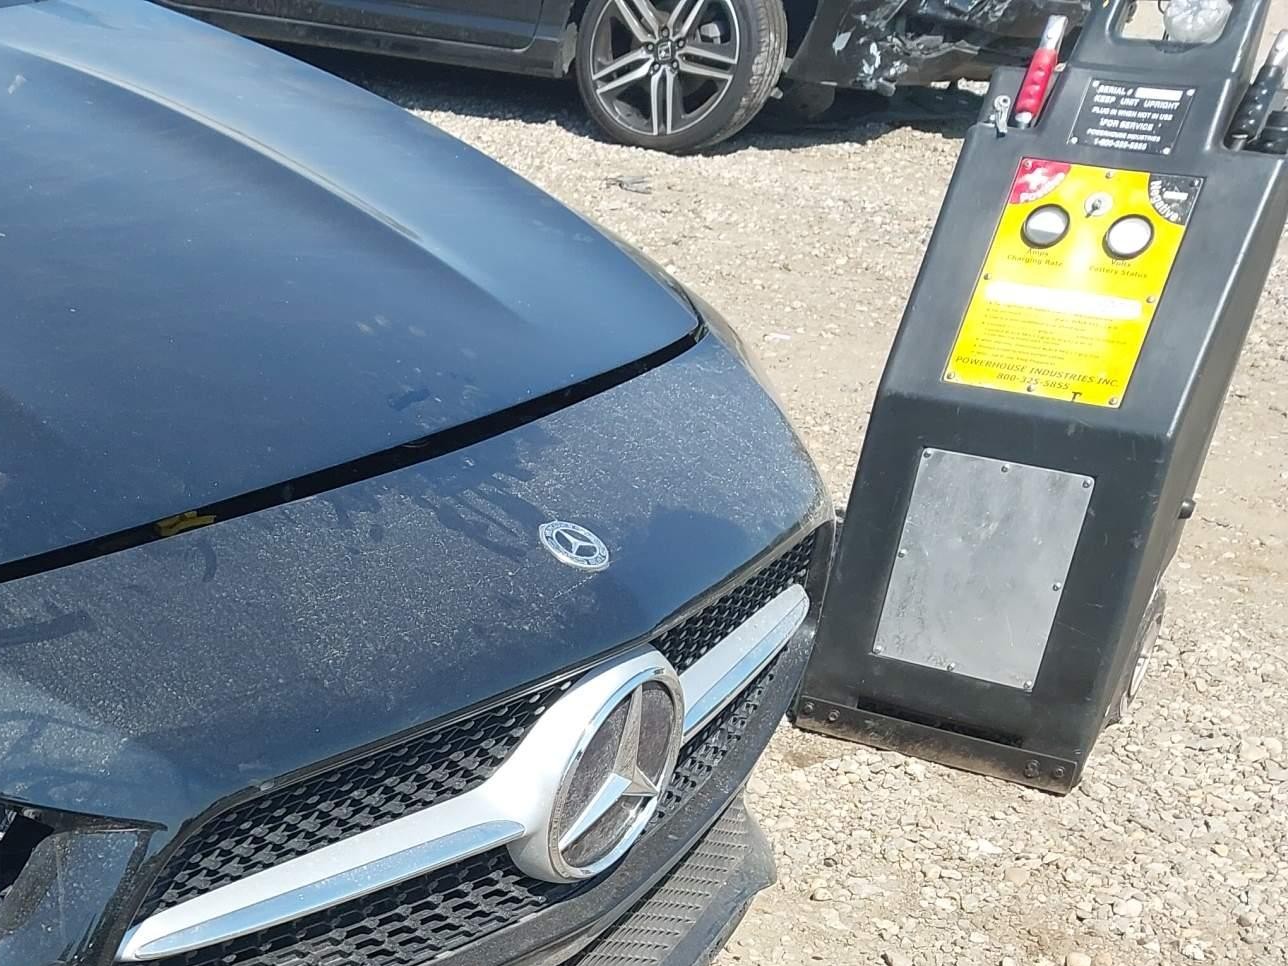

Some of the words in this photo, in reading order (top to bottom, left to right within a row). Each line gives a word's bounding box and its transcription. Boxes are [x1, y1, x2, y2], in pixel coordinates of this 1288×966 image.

[1094, 95, 1116, 104] KEEP
[1120, 97, 1140, 107] UNIT
[1143, 100, 1181, 110] UPRIGHT
[1092, 106, 1110, 115] PLUG
[1118, 109, 1138, 118] WHEN
[1138, 111, 1152, 119] NOT
[1159, 113, 1173, 121] USE
[1120, 121, 1154, 131] SERVICE
[1150, 180, 1179, 222] Negative
[1007, 254, 1042, 265] Charging
[1121, 270, 1148, 278] Status
[955, 356, 1027, 373] POWERHOUSE
[1029, 364, 1094, 384] INDUSTRIES
[996, 373, 1071, 390] 800-325-5855
